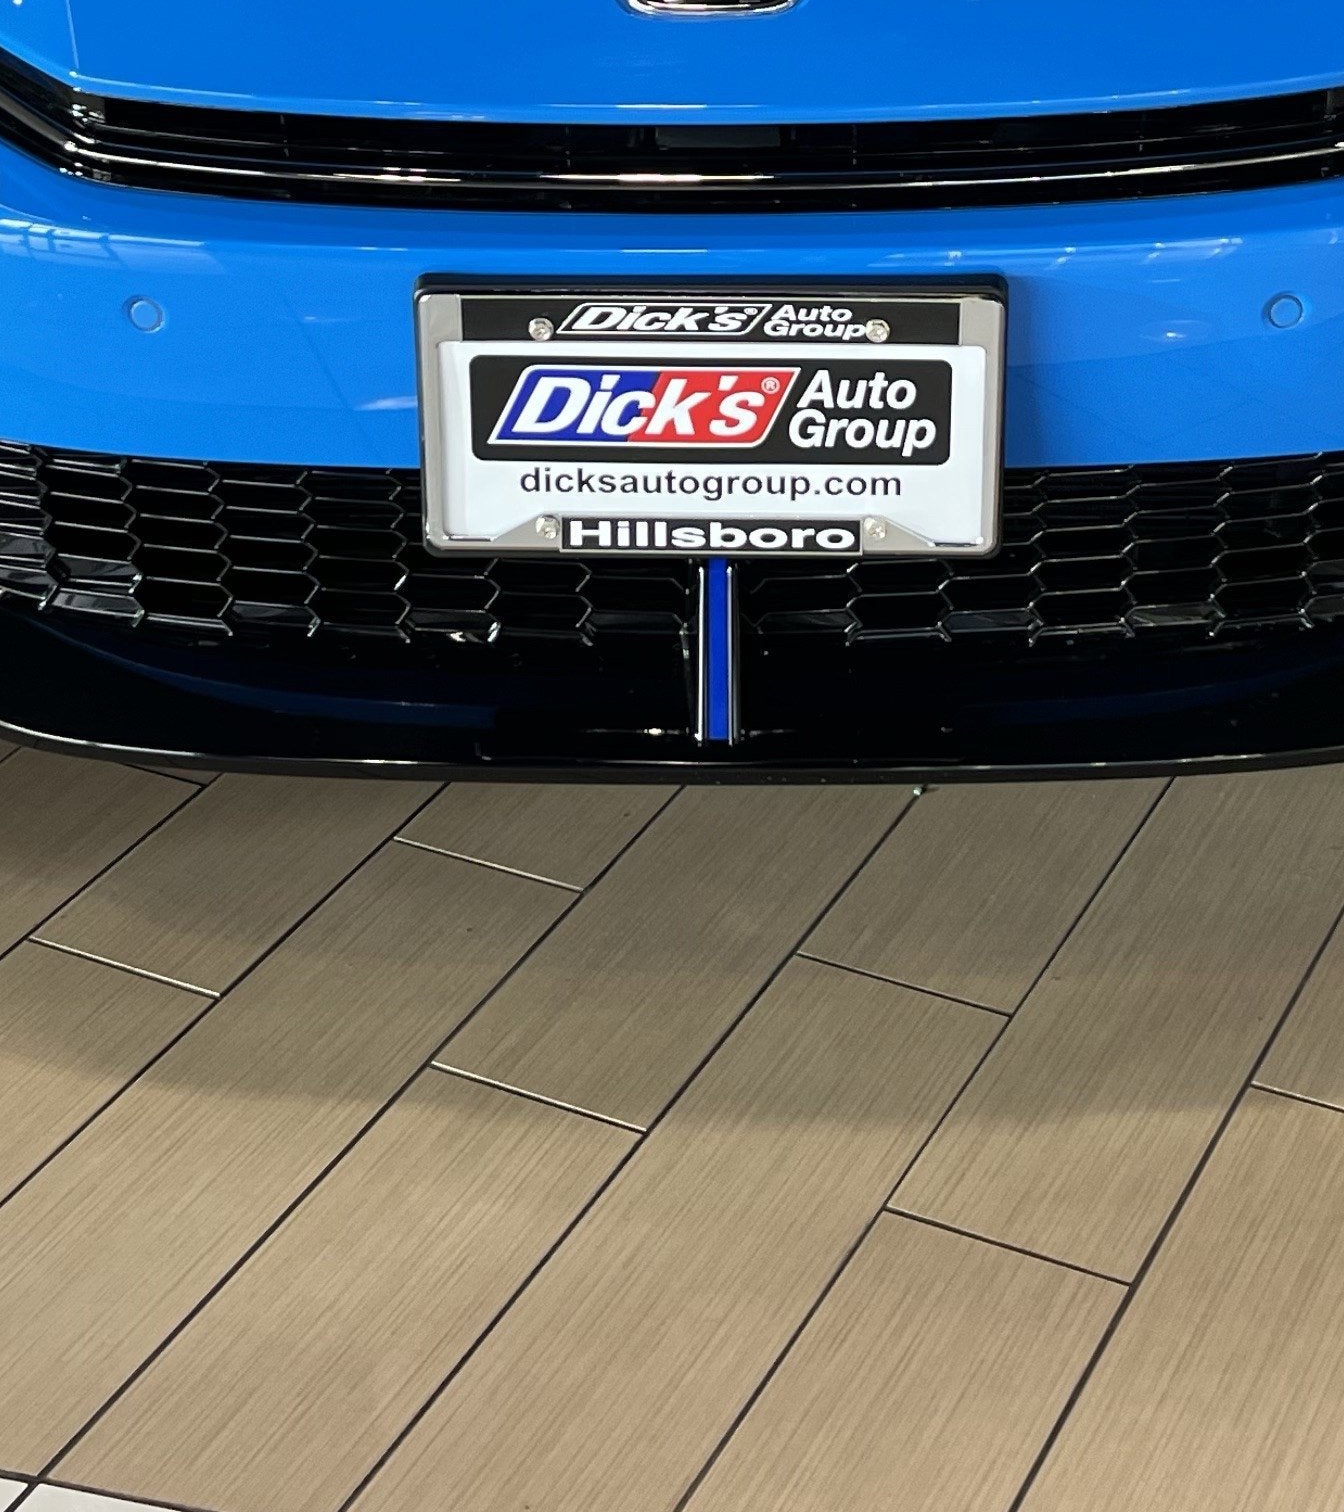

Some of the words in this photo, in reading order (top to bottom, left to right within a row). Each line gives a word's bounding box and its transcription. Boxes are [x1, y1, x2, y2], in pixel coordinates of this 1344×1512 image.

[572, 305, 747, 331] Dick's
[771, 304, 853, 322] Auto
[763, 319, 867, 340] Group
[512, 374, 766, 436] Dick's
[797, 370, 917, 410] Auto
[788, 409, 937, 457] Group
[520, 467, 902, 501] dicksautogroup.com
[569, 520, 855, 550] Hillsboro
